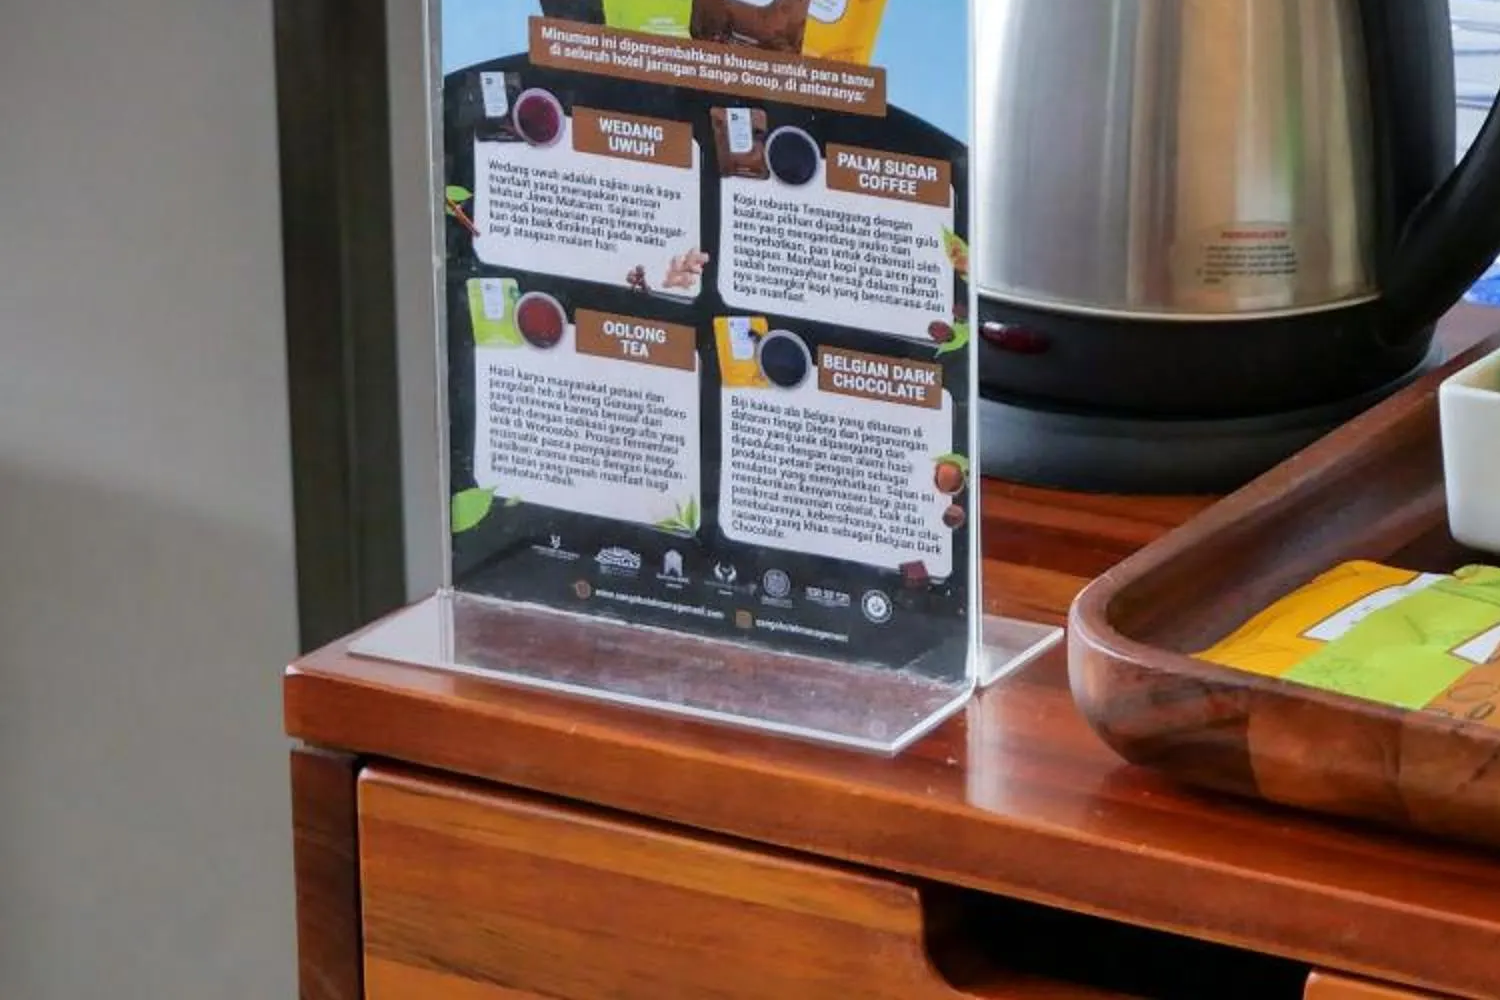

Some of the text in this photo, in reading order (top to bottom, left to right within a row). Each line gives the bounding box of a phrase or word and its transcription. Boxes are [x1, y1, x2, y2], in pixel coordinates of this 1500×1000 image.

[541, 26, 874, 88] Minuman ini dipersembahkan khusus untuk para tamu
[613, 52, 643, 67] hotel
[646, 56, 697, 77] jaringan
[786, 78, 798, 90] di
[598, 115, 664, 141] WEDANG
[608, 135, 655, 156] UWUH
[837, 152, 938, 182] PALM SUGAR
[859, 173, 918, 196] COFFEE
[603, 320, 667, 343] OOLONG
[620, 339, 650, 357] TEA
[823, 353, 936, 386] BELGIAN DARK
[832, 372, 926, 401] CHOCOLATE
